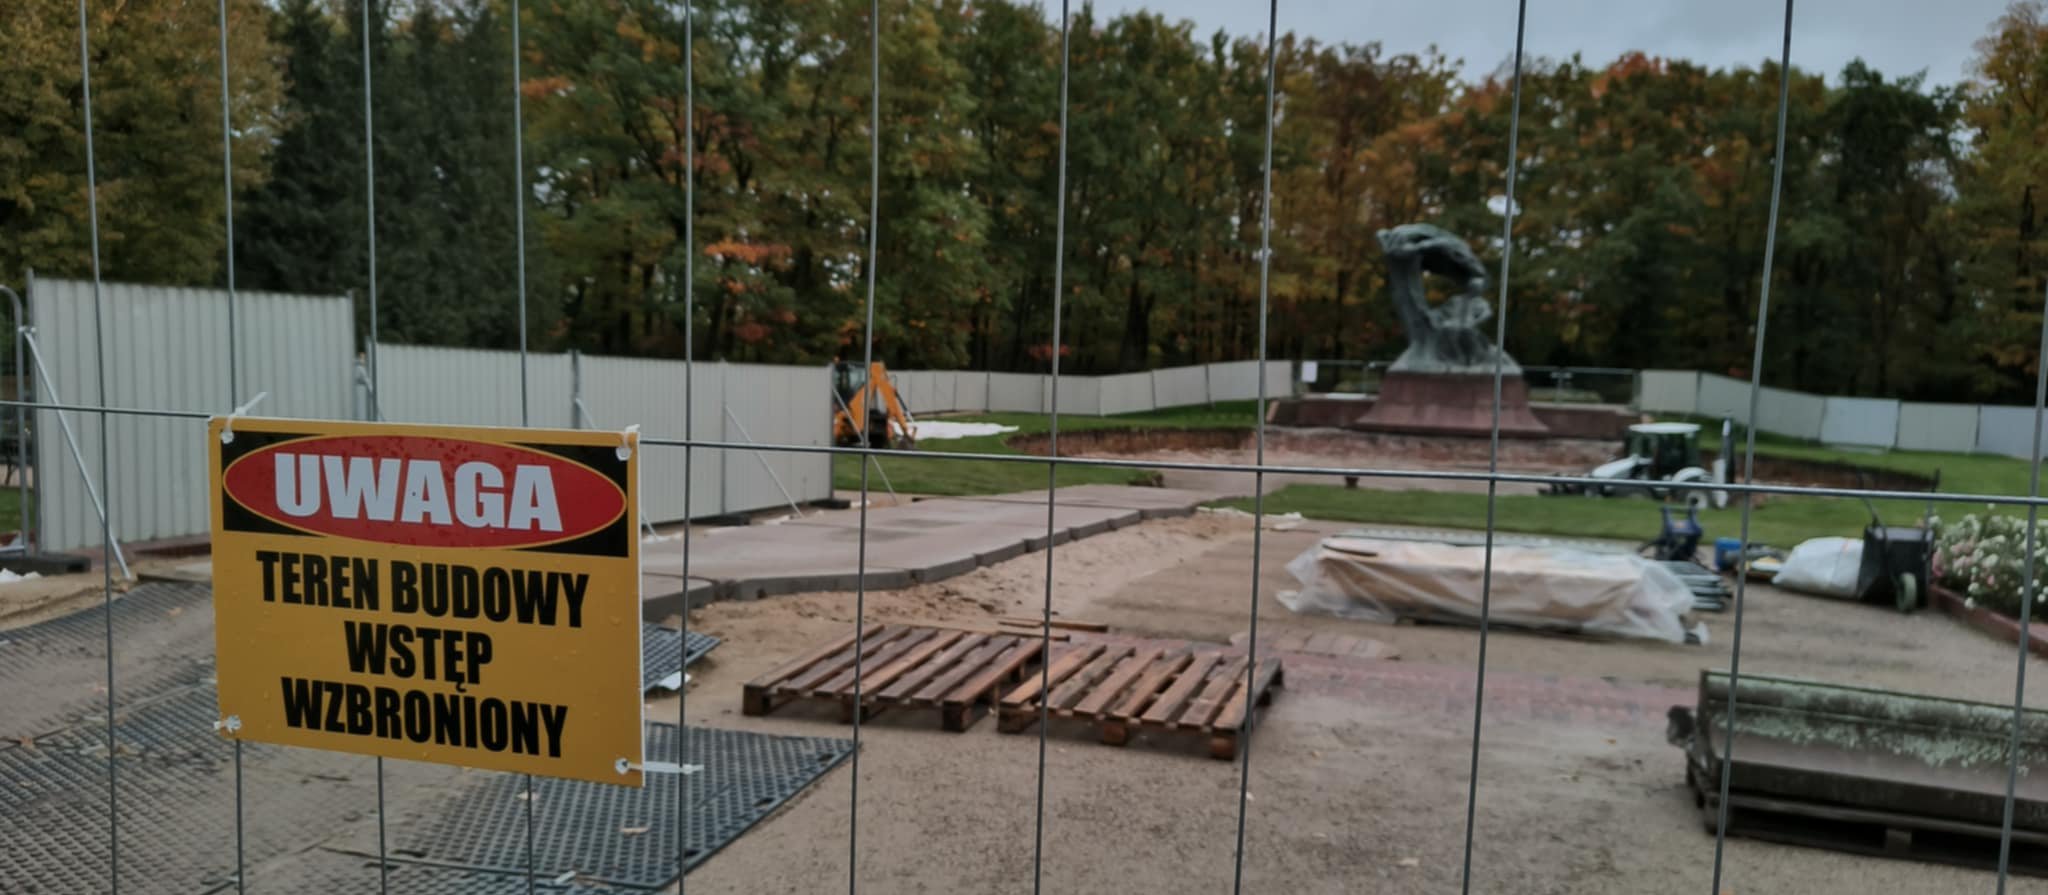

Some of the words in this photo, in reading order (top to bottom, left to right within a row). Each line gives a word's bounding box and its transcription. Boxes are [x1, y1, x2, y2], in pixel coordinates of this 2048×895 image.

[274, 452, 563, 532] UWAGA
[256, 550, 380, 611] TEREN
[390, 560, 590, 628] BUDOWY
[344, 620, 493, 692] WSTĘP
[280, 676, 568, 758] WZBRONIONY
